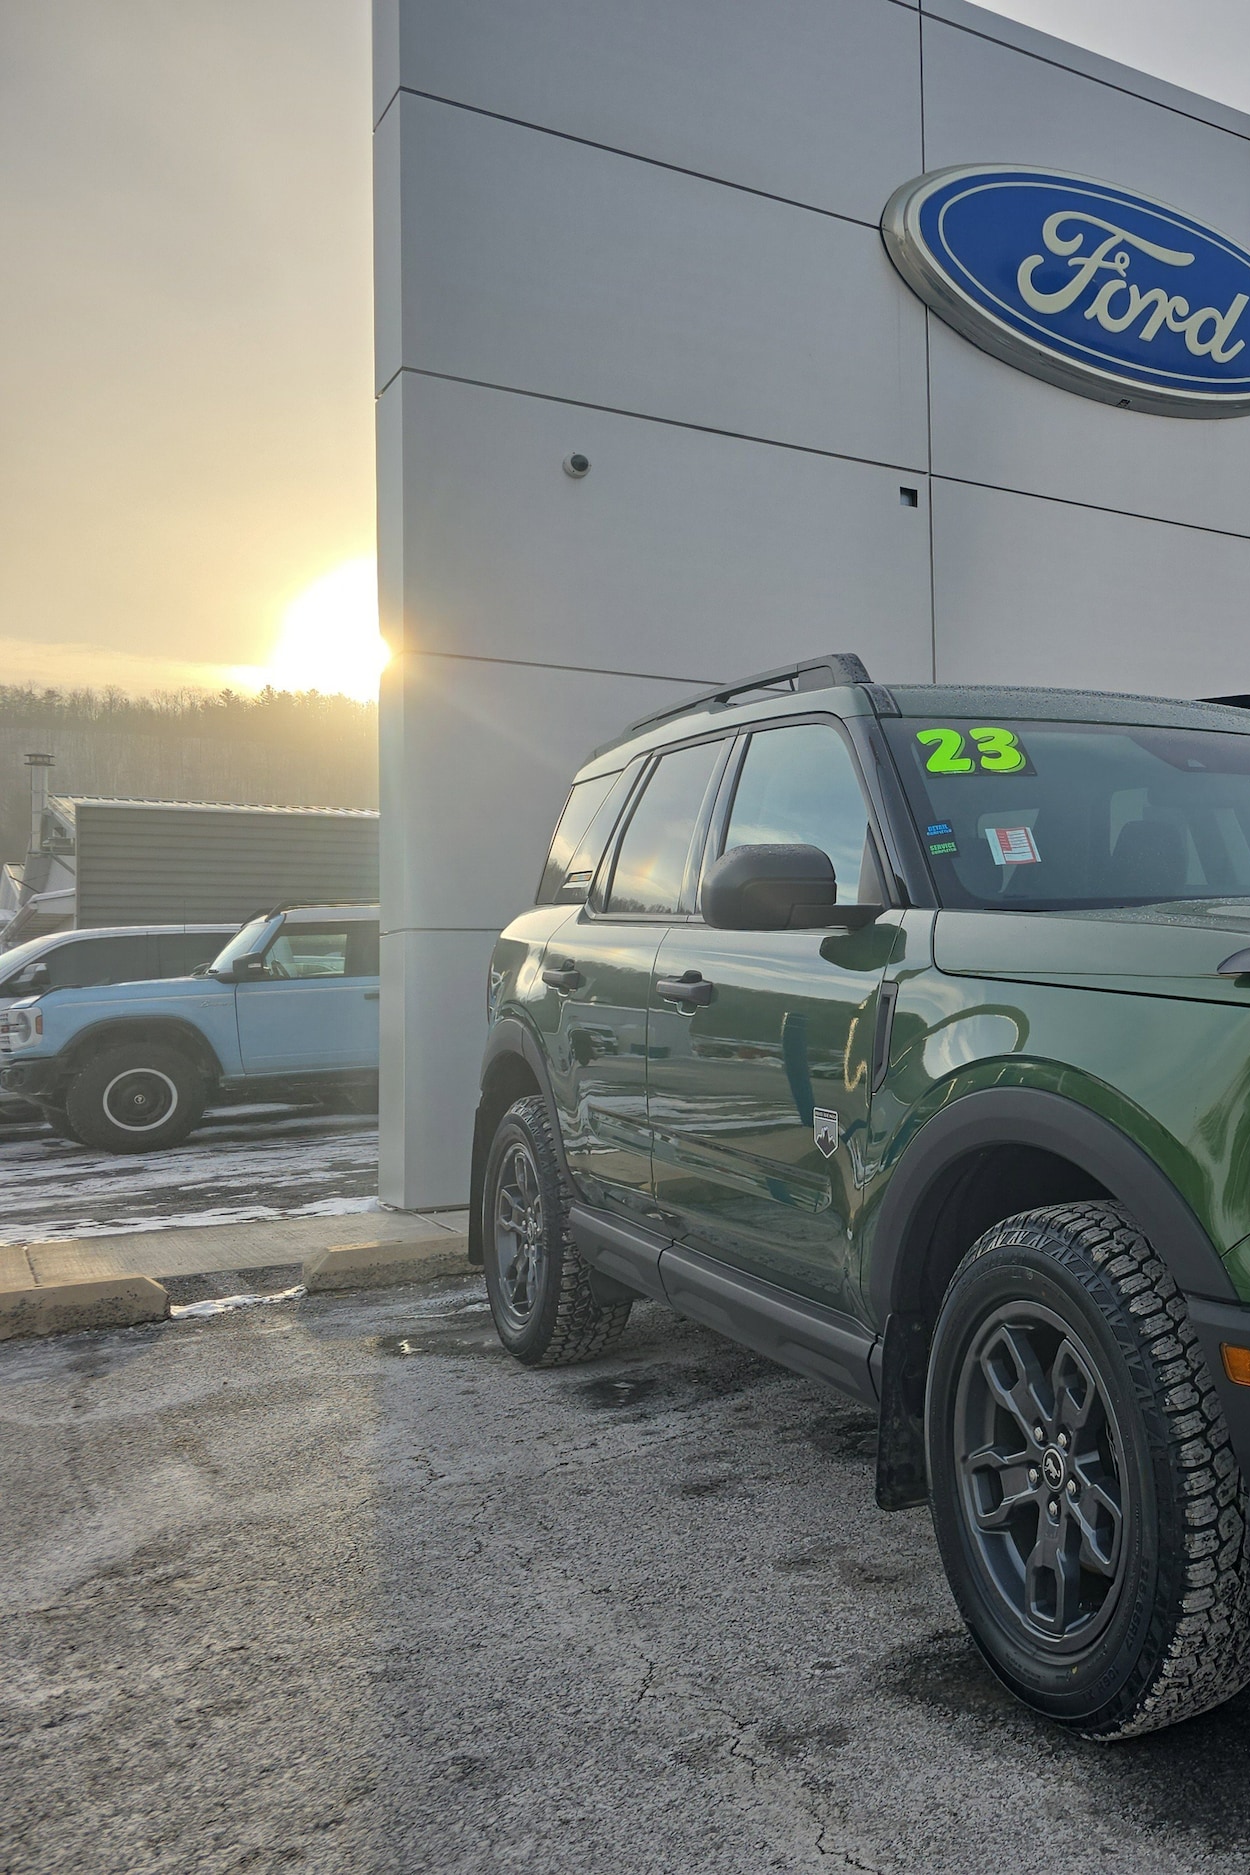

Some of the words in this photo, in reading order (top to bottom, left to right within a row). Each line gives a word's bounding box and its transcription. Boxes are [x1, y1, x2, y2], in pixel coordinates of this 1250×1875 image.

[1017, 210, 1249, 364] Ford
[916, 727, 1026, 774] 23
[929, 841, 956, 851] SERVICE
